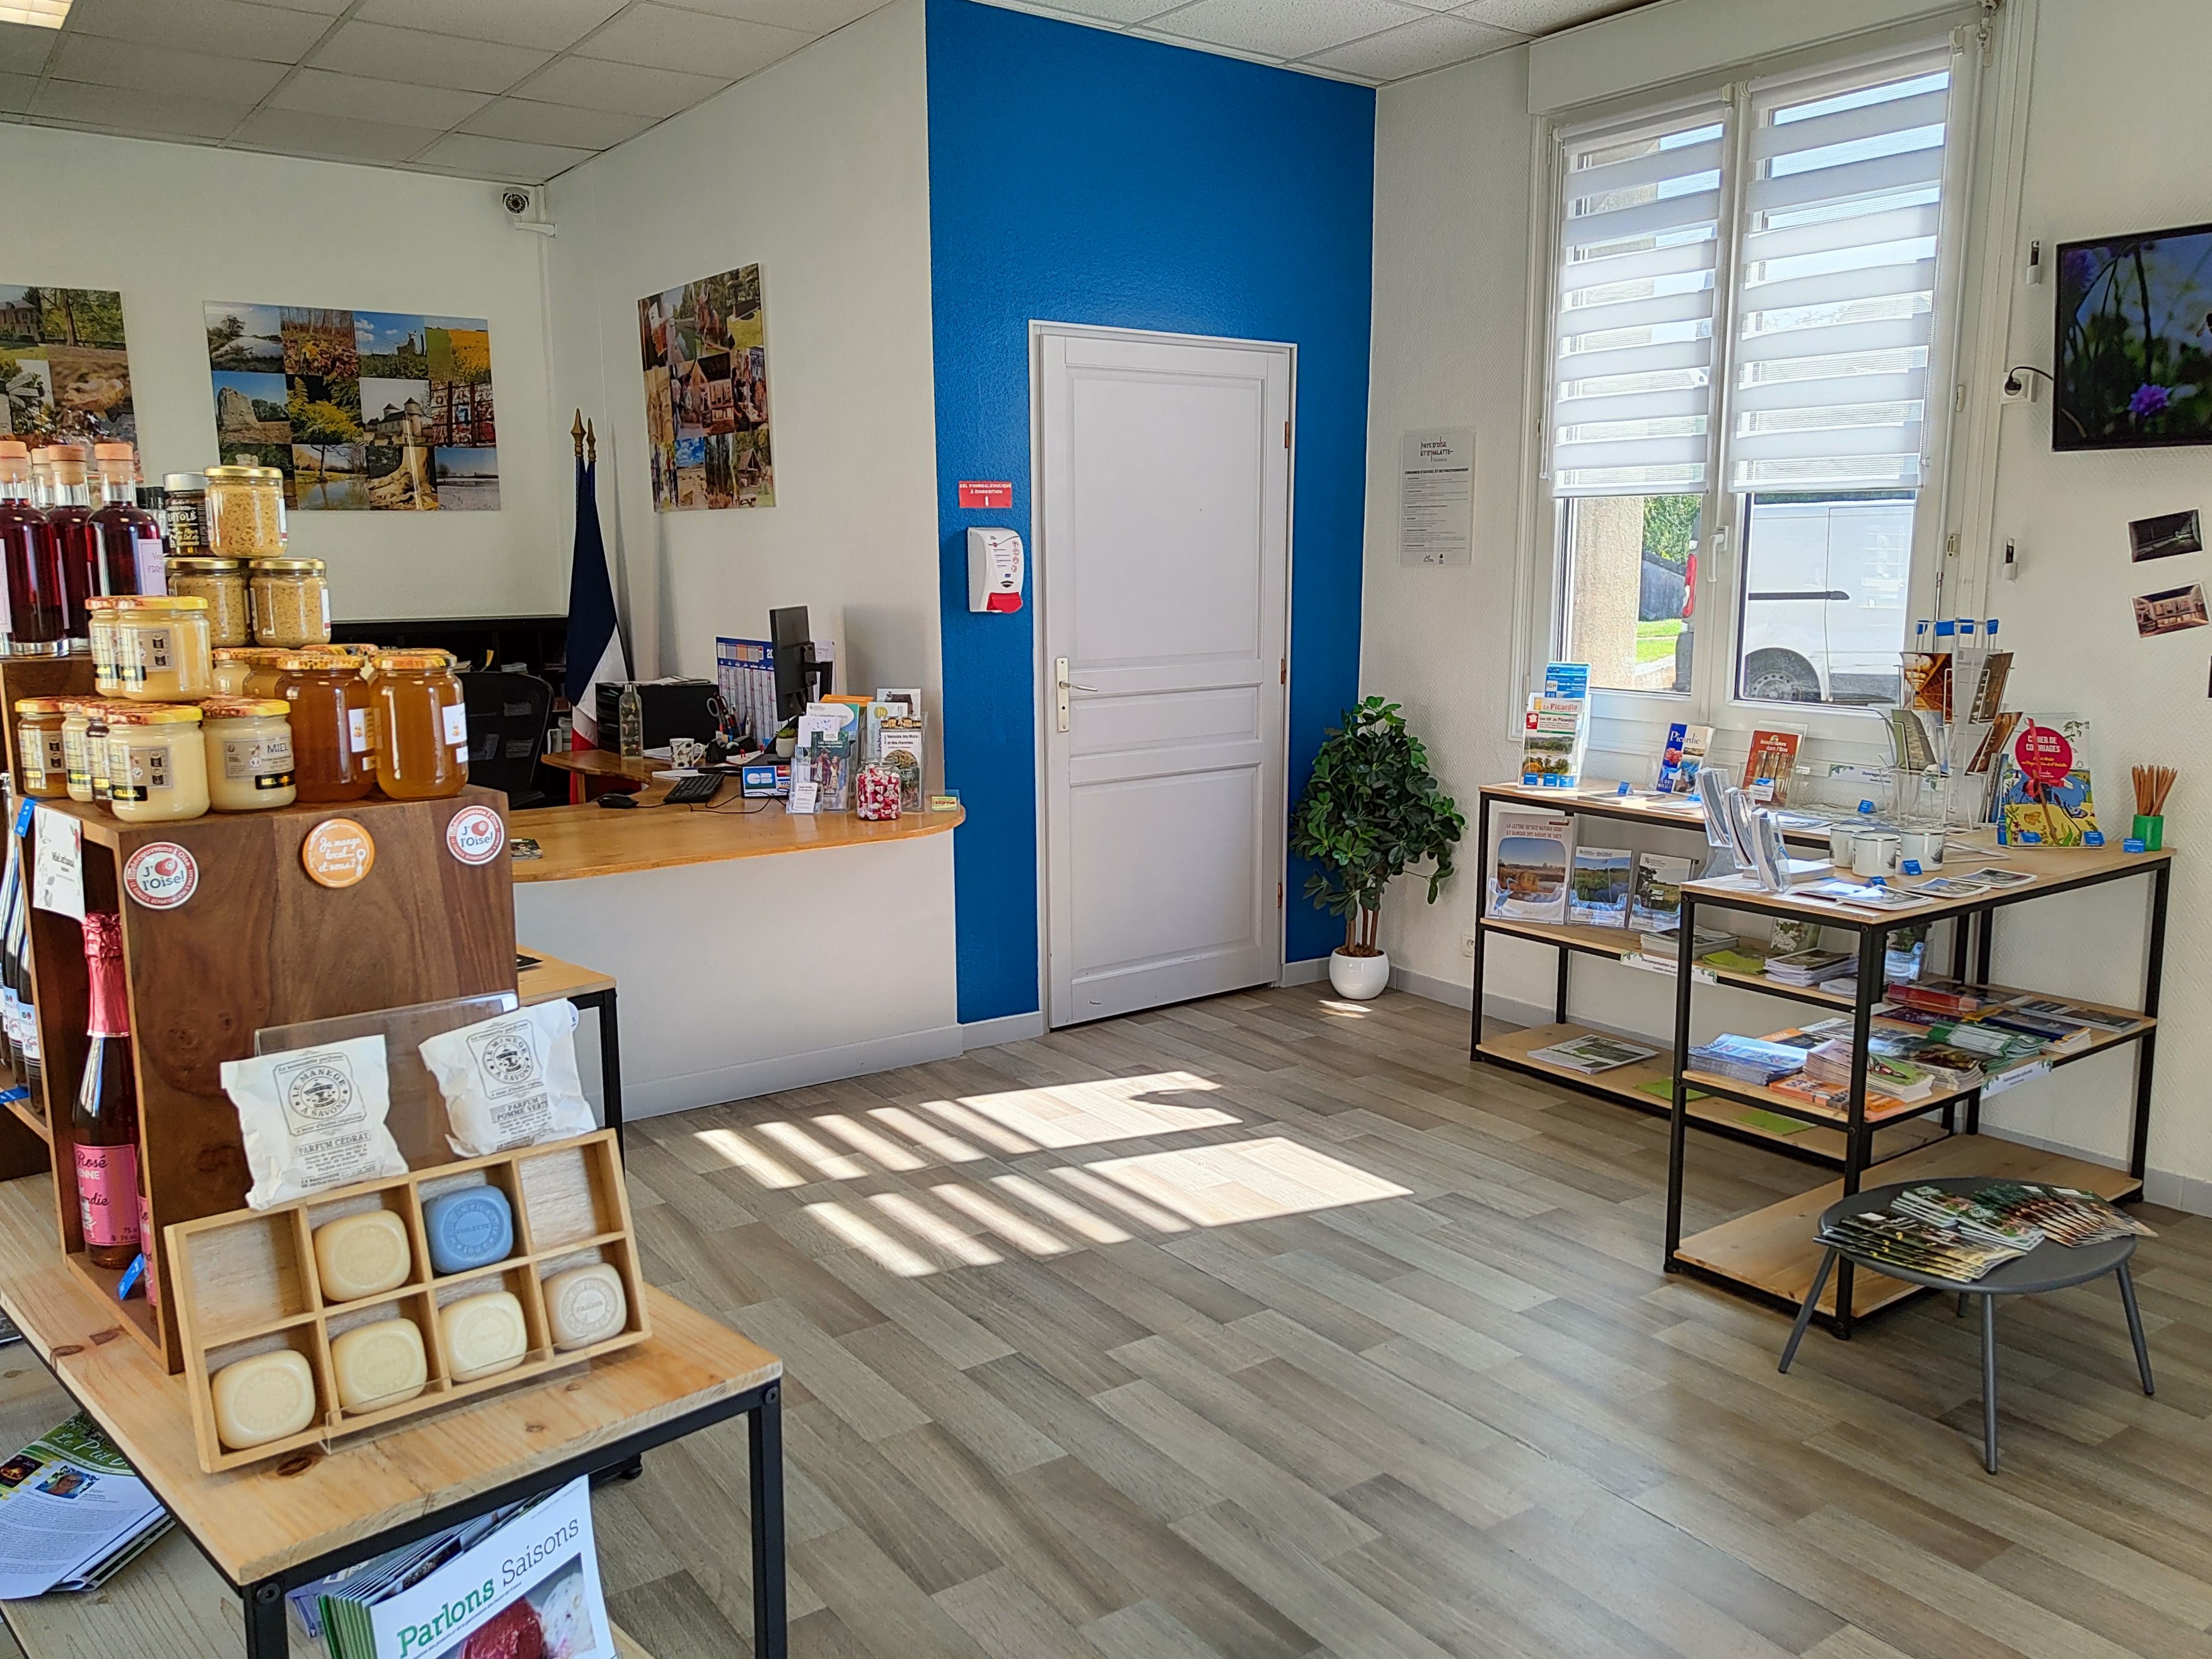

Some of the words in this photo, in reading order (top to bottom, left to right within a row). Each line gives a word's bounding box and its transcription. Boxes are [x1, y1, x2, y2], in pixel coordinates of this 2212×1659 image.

[1550, 703, 1578, 711] Picardie
[1670, 731, 1700, 744] Picardie
[2049, 736, 2058, 744] DE
[267, 743, 288, 753] MIEL
[320, 837, 333, 853] Je
[334, 838, 361, 850] mange
[292, 1084, 301, 1098] LE
[311, 1098, 347, 1117] SAVONS
[507, 1097, 540, 1111] PARFUM
[497, 1107, 525, 1121] POMME
[299, 1140, 333, 1155] PARFUM
[77, 1151, 108, 1168] Rosé
[52, 1432, 74, 1446] Le
[397, 1577, 495, 1659] Parlons
[501, 1518, 579, 1588] Saisons
